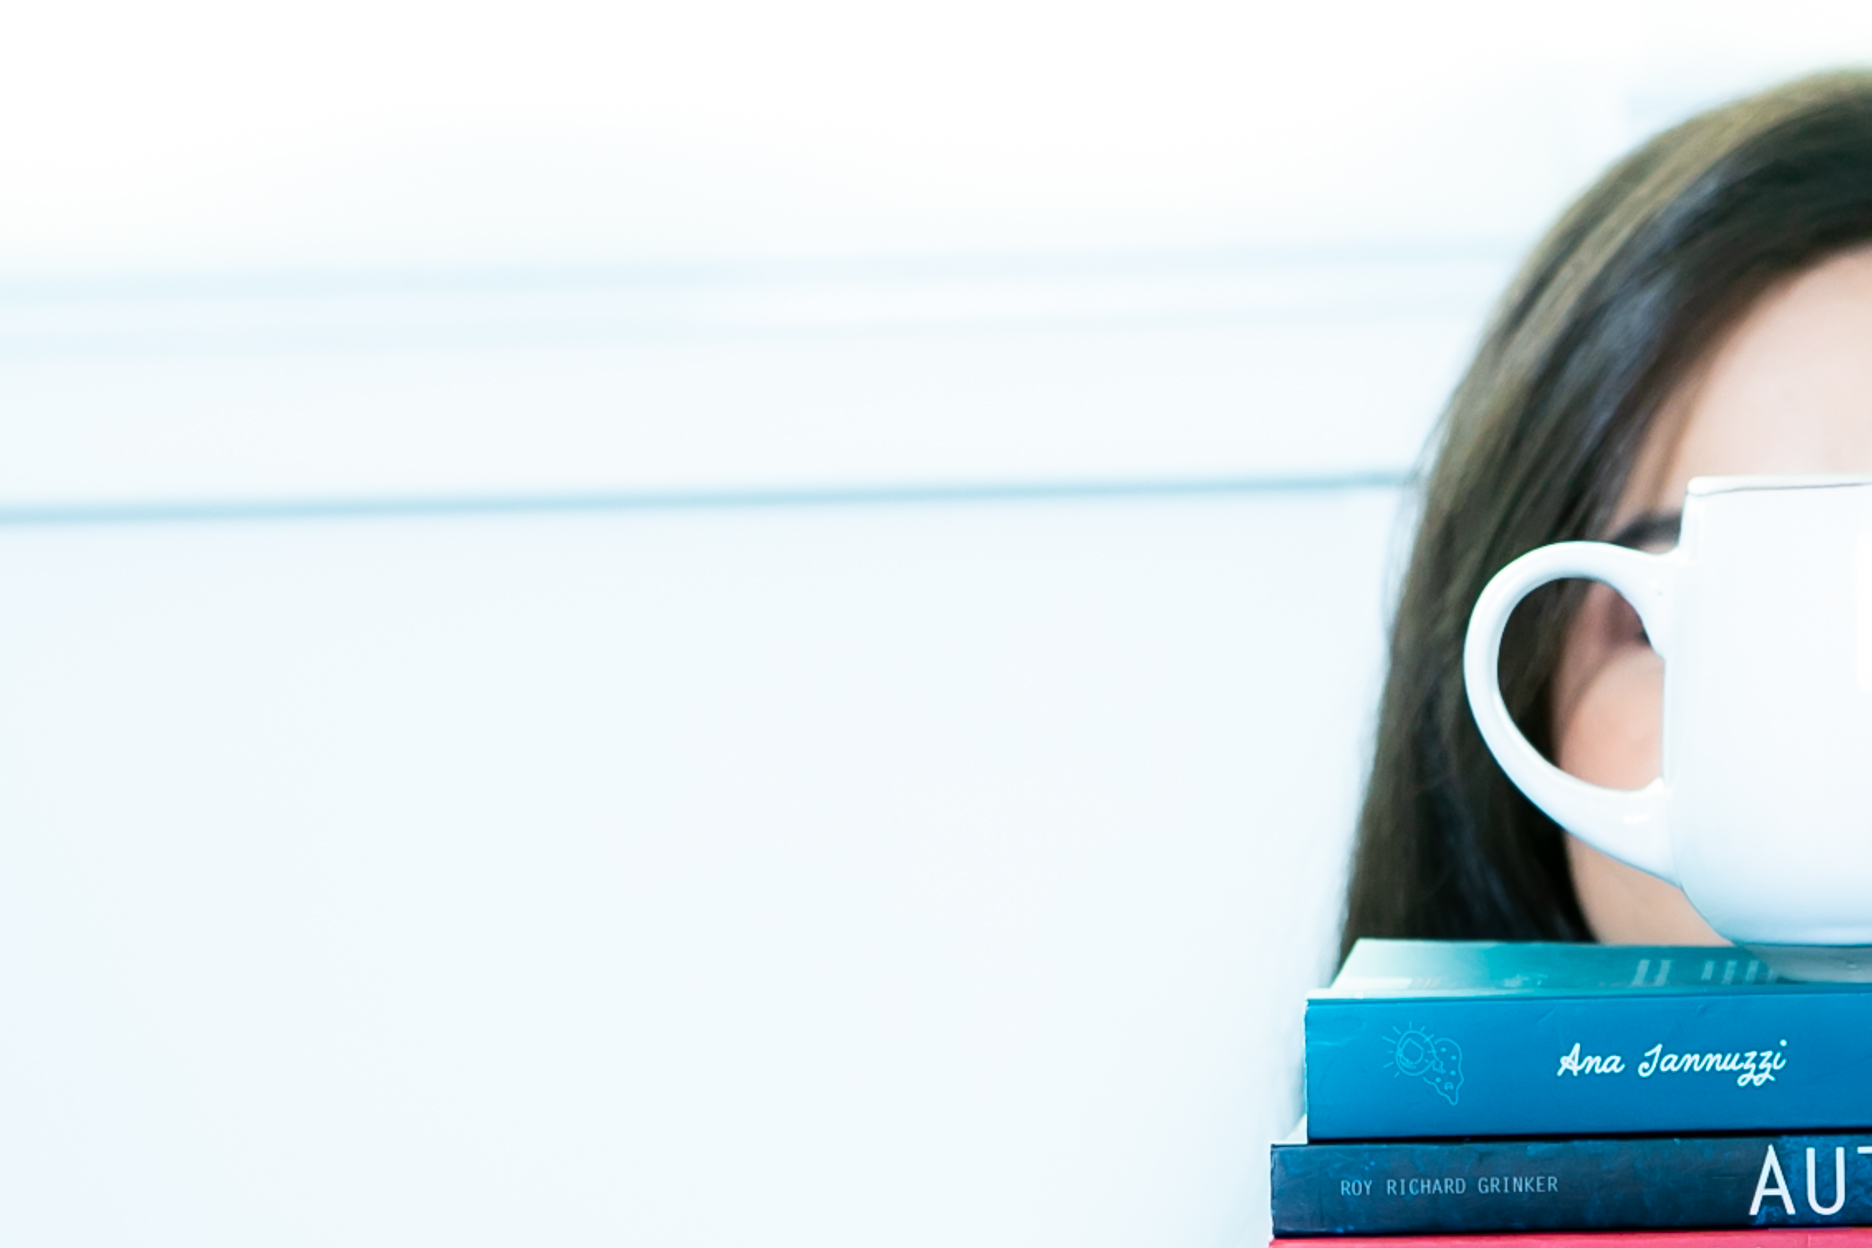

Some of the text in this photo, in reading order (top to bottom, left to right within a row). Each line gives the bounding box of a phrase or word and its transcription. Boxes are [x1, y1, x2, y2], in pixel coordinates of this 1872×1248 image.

[1557, 1042, 1626, 1078] Ana
[1339, 1175, 1559, 1197] ROY RICHARD GRINKER
